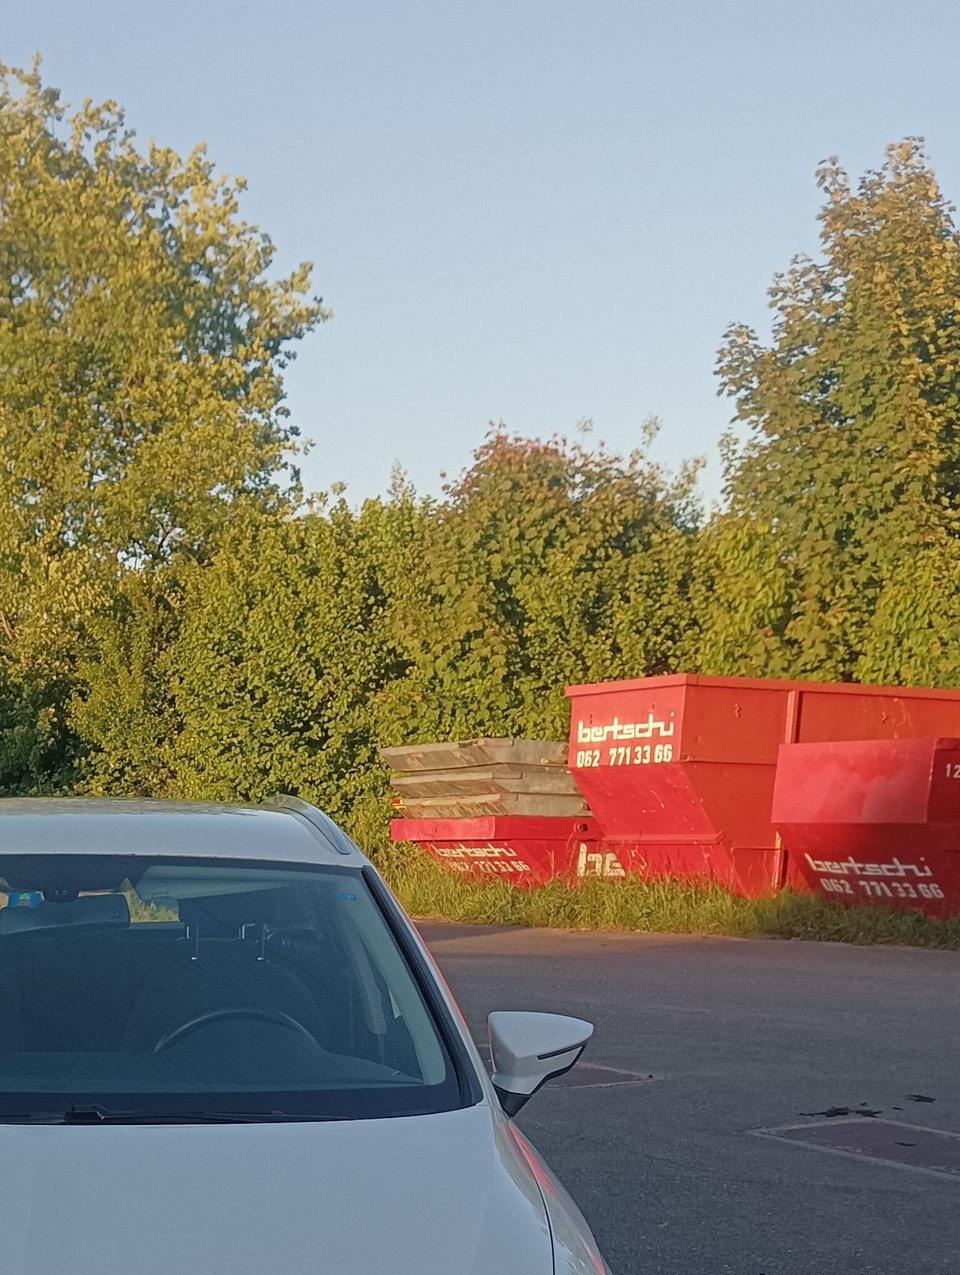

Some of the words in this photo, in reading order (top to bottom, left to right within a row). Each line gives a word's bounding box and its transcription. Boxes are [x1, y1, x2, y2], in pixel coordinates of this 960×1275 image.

[577, 711, 675, 743] bertschi
[576, 749, 600, 768] 062
[609, 746, 631, 767] 771
[633, 744, 651, 765] 33
[653, 743, 673, 764] 66
[430, 842, 518, 858] bertschi
[804, 852, 933, 877] bertschi
[820, 878, 855, 895] 062
[859, 880, 894, 898] 771
[892, 882, 918, 899] 33
[917, 883, 945, 899] 66
